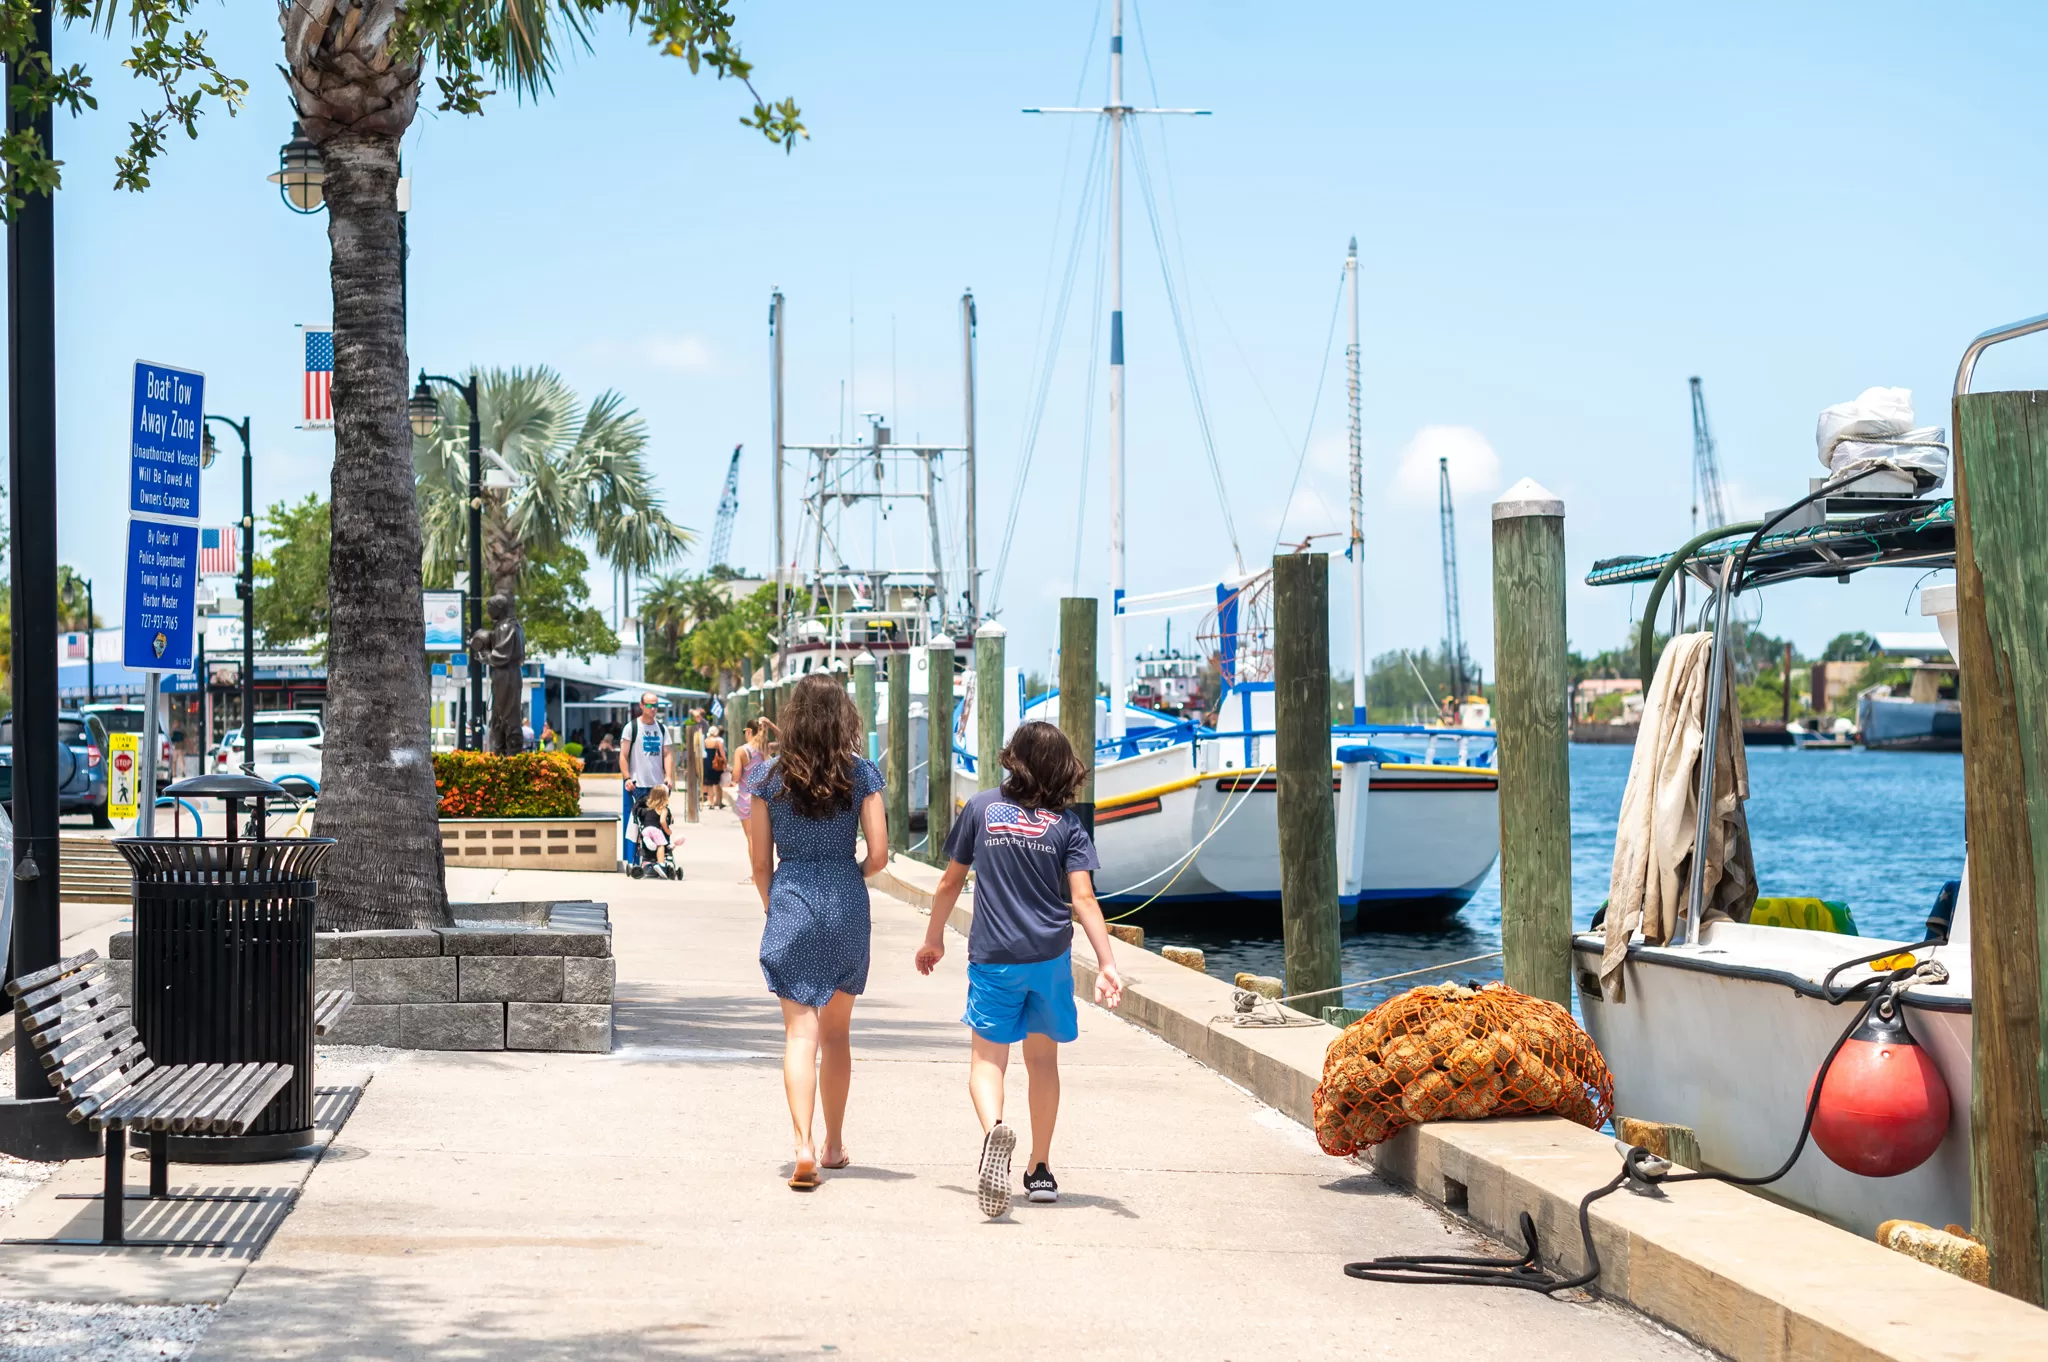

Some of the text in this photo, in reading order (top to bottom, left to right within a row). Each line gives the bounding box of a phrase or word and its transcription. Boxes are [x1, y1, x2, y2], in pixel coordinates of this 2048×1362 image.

[147, 371, 192, 405] Boat Tow
[140, 405, 195, 442] Away Zone
[133, 443, 198, 467] Unauthorized Vessels
[138, 466, 192, 488] Will Be Towed At
[140, 489, 190, 511] Owners Expense
[147, 529, 179, 547] By Order Of
[138, 550, 186, 569] Police Department
[141, 570, 182, 590] Towing Info Call
[142, 592, 179, 609] Harbor Master
[141, 613, 178, 630] 727-937-9165
[115, 758, 132, 768] STOP
[1027, 840, 1057, 854] vines
[1029, 1179, 1053, 1189] adidas
